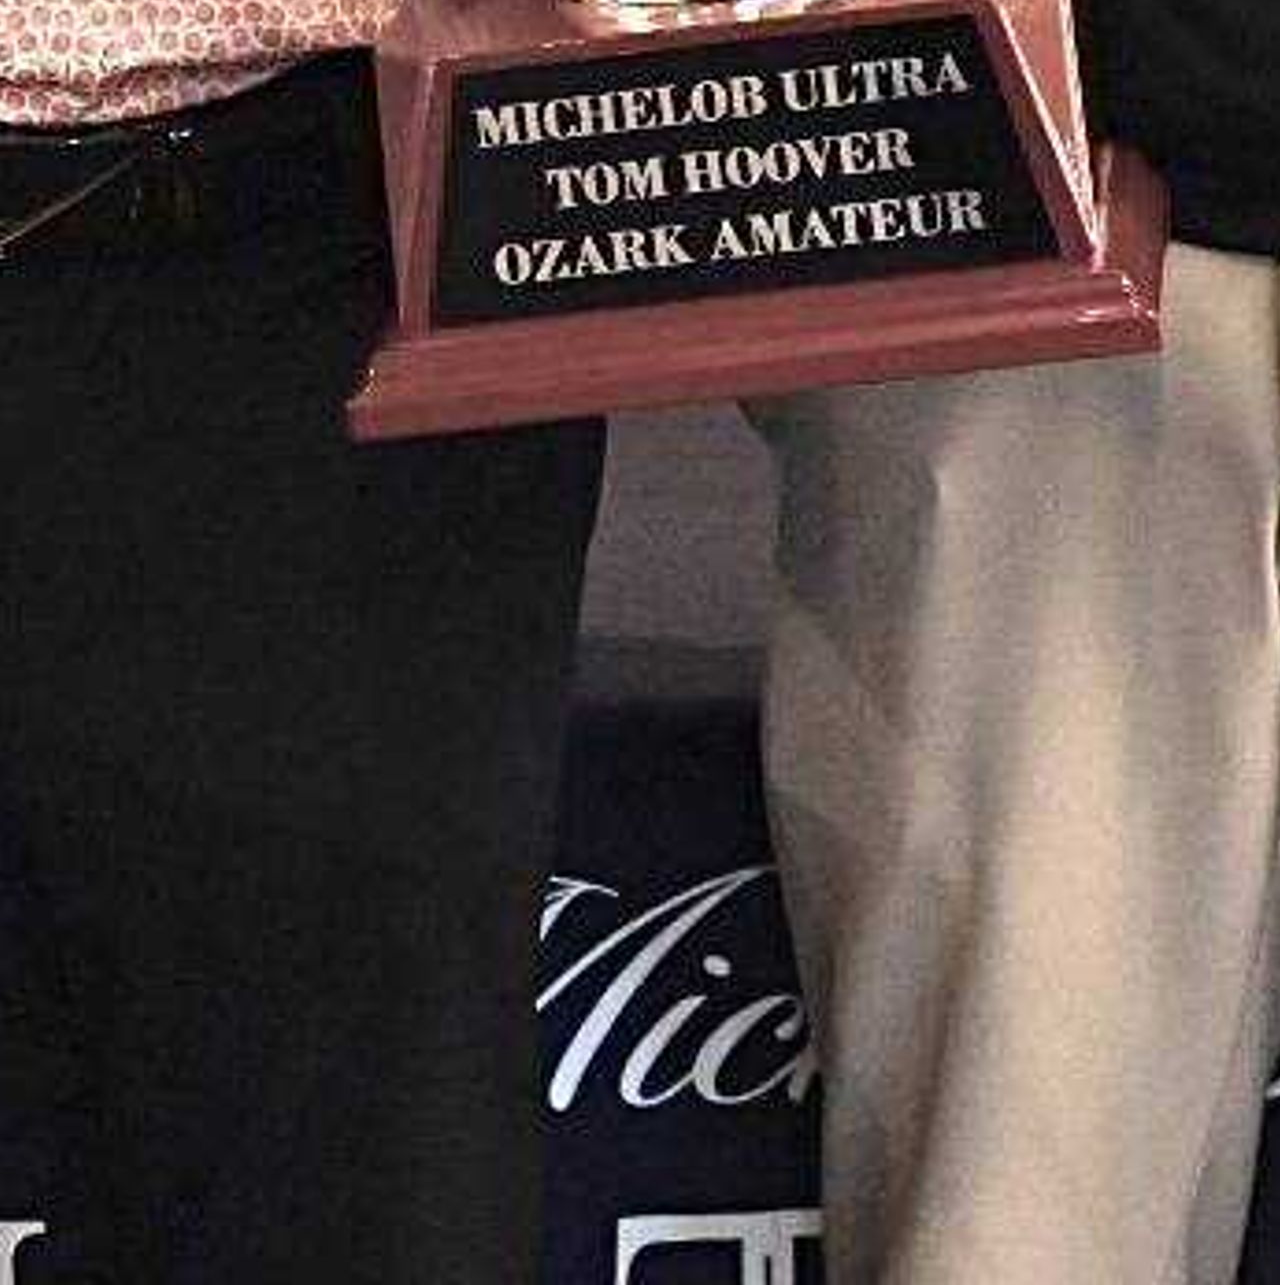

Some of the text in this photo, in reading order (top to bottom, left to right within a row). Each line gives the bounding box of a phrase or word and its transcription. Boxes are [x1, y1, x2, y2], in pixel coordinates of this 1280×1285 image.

[473, 51, 971, 149] MICHELOB ULTRA
[546, 128, 916, 211] TOM HOOVER
[493, 189, 986, 286] OZARK AMATEUR
